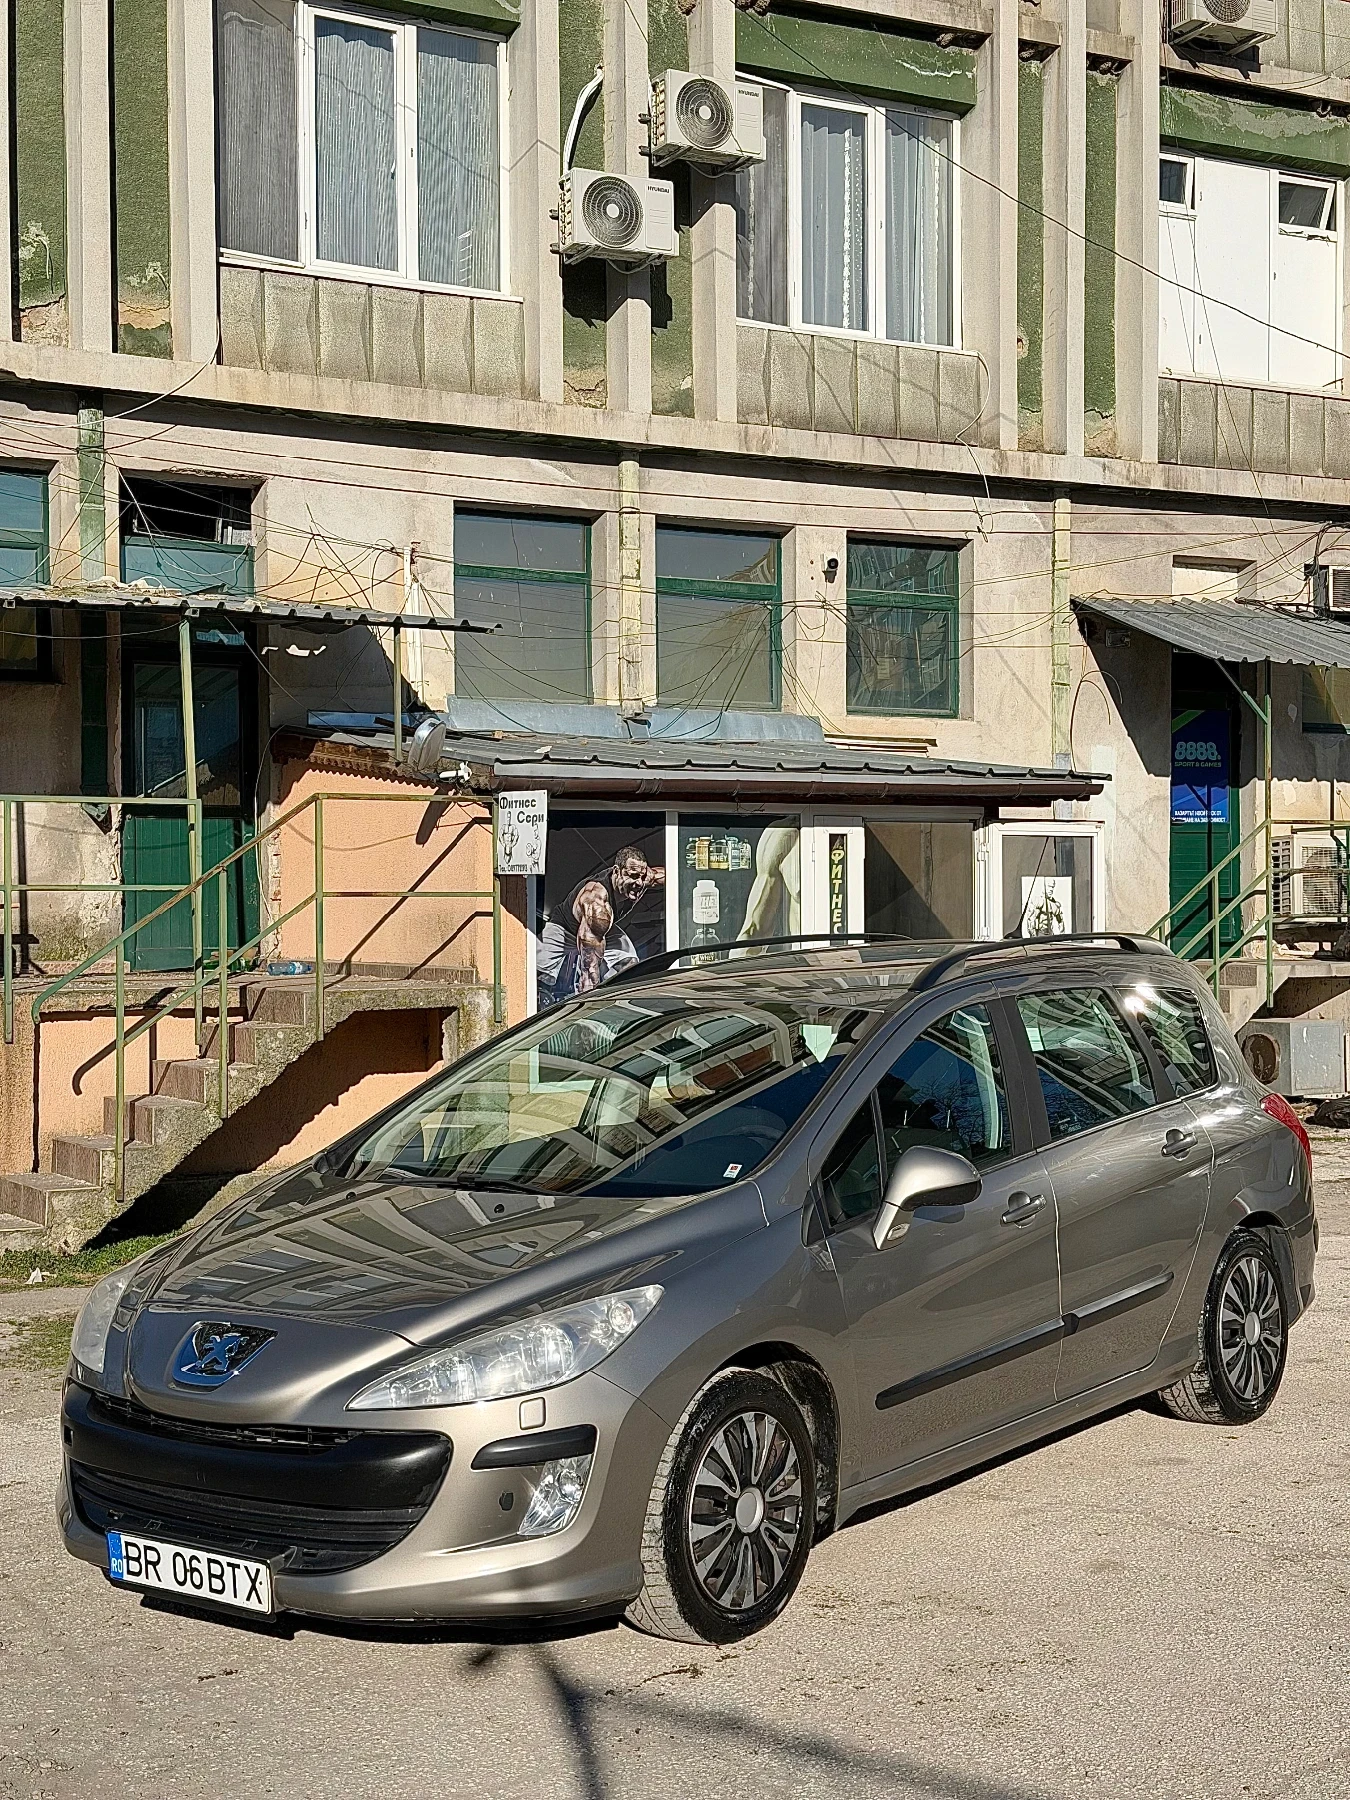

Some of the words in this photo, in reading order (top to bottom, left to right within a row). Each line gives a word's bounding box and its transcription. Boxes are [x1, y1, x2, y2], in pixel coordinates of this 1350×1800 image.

[737, 89, 760, 98] HYUNDAI
[647, 185, 670, 194] HYUNDAI
[709, 854, 728, 863] WHEY
[831, 849, 845, 935] ФИТНЕС
[111, 1558, 123, 1574] RO
[124, 1540, 163, 1583] BR
[172, 1551, 263, 1606] 06BTX
